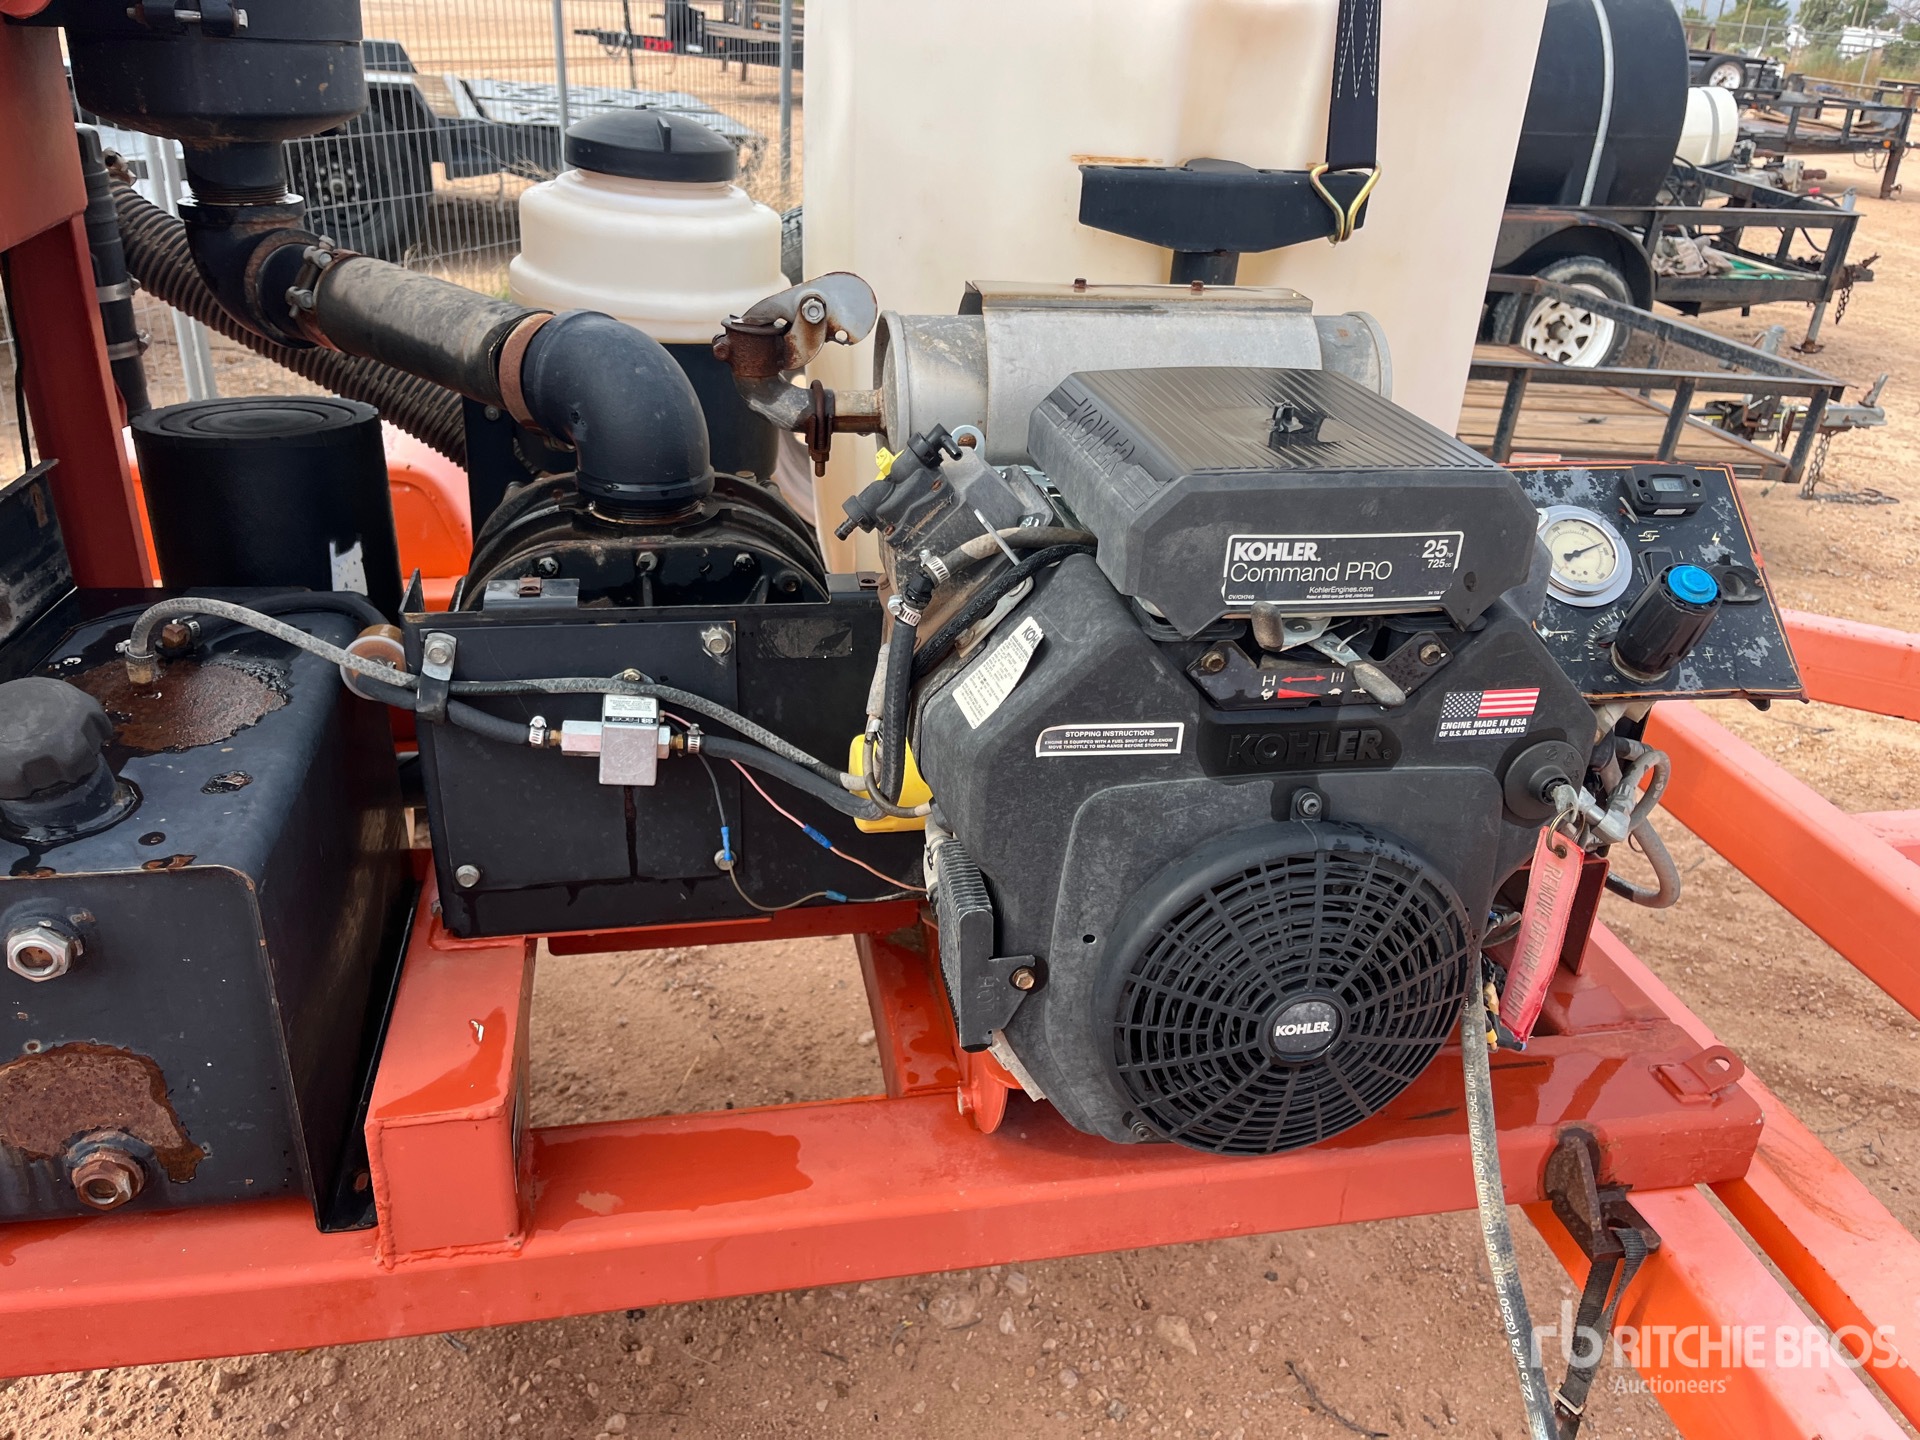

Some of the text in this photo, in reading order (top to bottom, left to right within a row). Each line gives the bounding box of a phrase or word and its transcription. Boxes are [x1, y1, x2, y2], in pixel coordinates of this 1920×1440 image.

[1061, 403, 1135, 478] KOHLER
[1230, 562, 1340, 582] Command
[1345, 561, 1393, 581] PRO
[1309, 586, 1373, 594] KohlerEngines.com
[1021, 625, 1041, 649] KOH
[1441, 718, 1527, 730] ENGINE MADE IN USA
[1478, 728, 1503, 736] GLOBAL
[1505, 863, 1563, 1021] REMOVE BEFORE FLIGHT
[1492, 1266, 1506, 1295] PSI)
[1500, 1298, 1519, 1336] (3250
[1511, 1338, 1527, 1369] MPa
